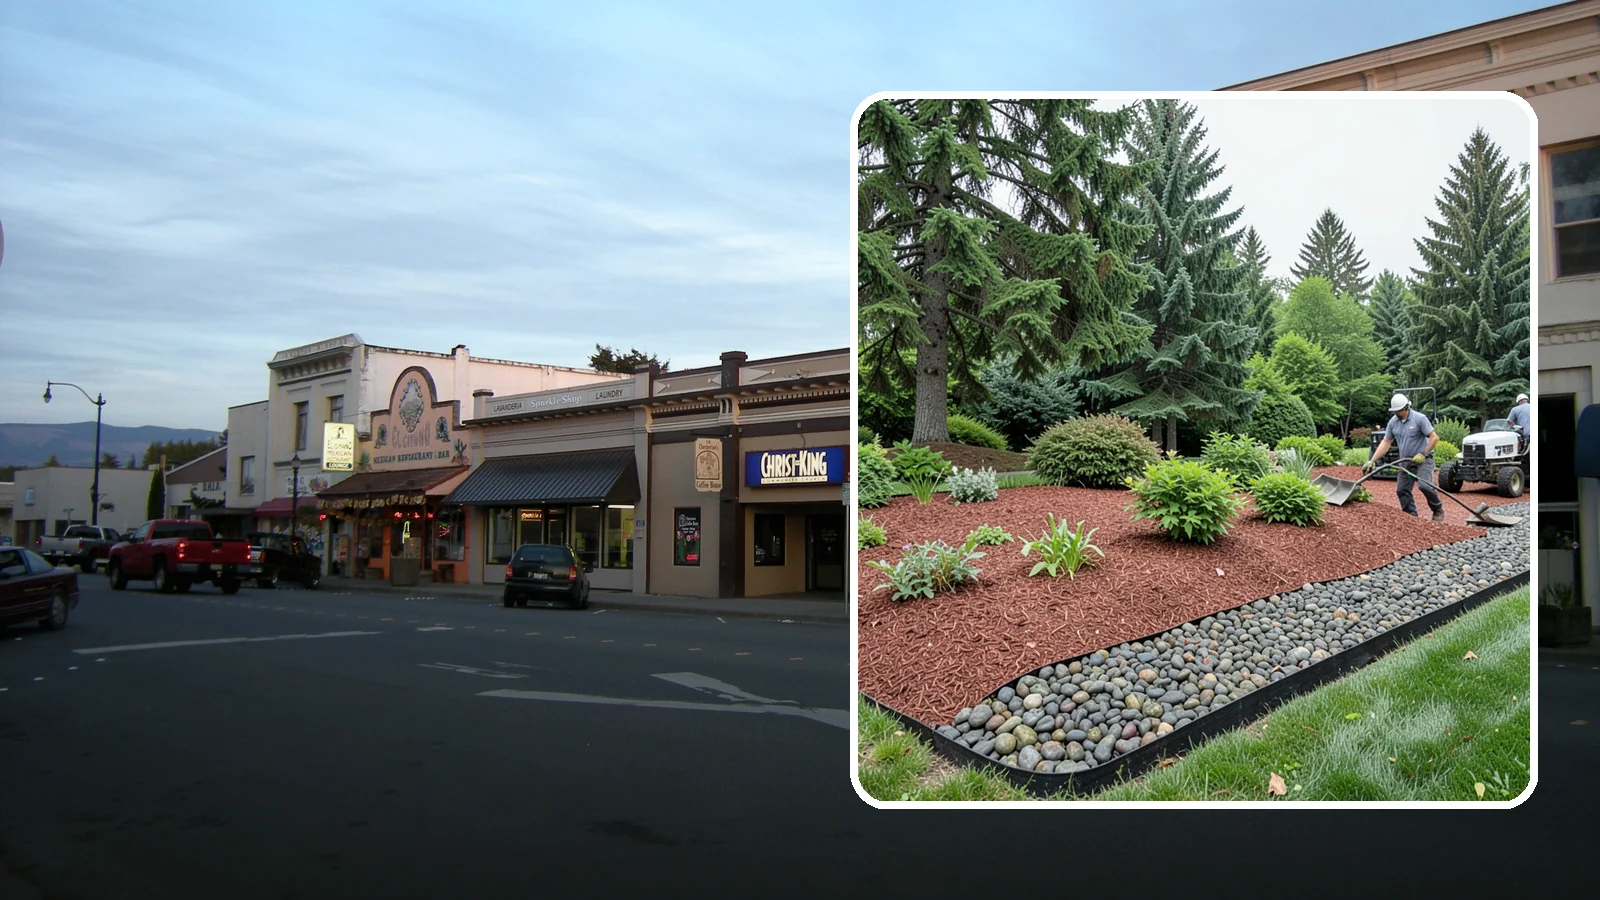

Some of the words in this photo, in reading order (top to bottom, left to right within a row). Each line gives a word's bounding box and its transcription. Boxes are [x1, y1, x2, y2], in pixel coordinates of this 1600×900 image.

[494, 402, 523, 413] LAVANDERIA
[531, 397, 561, 409] Sparkle
[561, 395, 583, 405] Shop
[596, 388, 624, 400] LAUNDRY
[373, 454, 396, 464] MEXICAN
[397, 451, 434, 462] RESTAURANT
[437, 450, 450, 459] BAR
[760, 452, 798, 478] CHRIST
[798, 450, 828, 476] KING
[696, 481, 710, 489] Coffee
[710, 481, 722, 489] House
